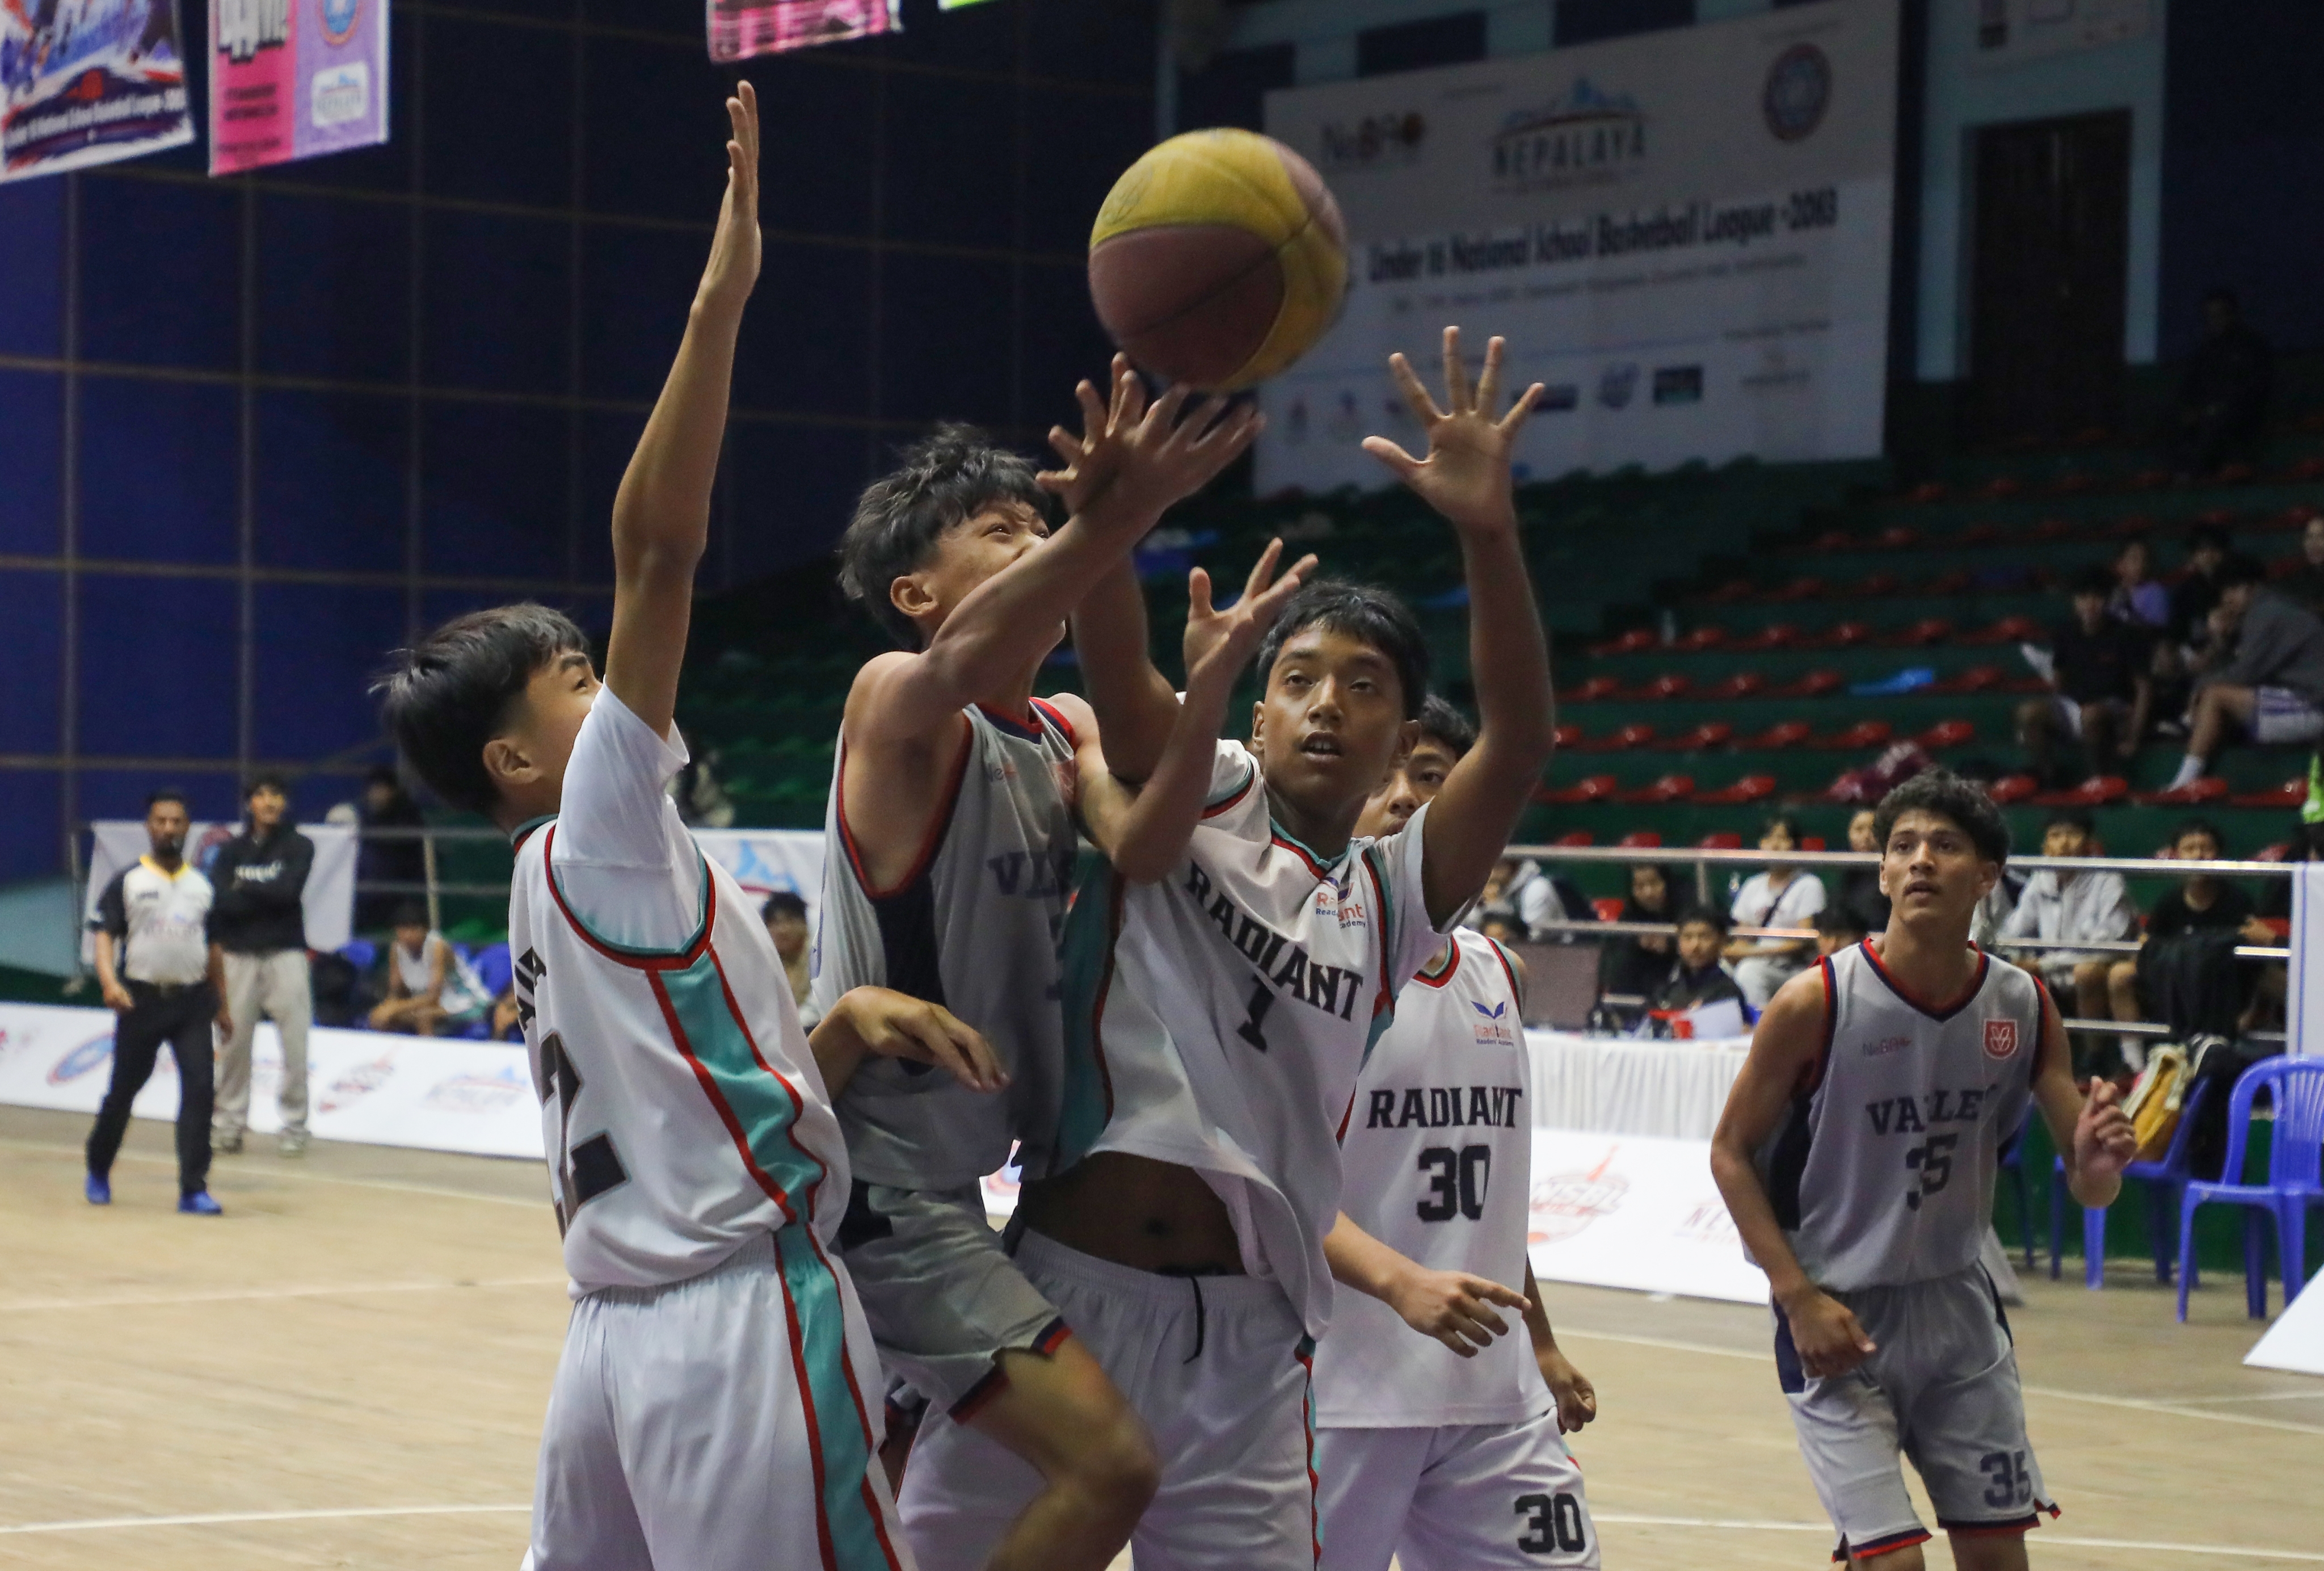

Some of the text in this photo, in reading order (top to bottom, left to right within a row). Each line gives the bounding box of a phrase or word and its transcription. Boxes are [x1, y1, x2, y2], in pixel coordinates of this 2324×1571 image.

[1492, 123, 1645, 177] NEPALAYA
[1186, 859, 1365, 1022] RADIANT
[1236, 974, 1275, 1053] 1
[1366, 1086, 1523, 1129] RADIANT
[1416, 1144, 1492, 1223] 30
[1980, 1450, 2032, 1508] 35
[1514, 1492, 1586, 1554] 30
